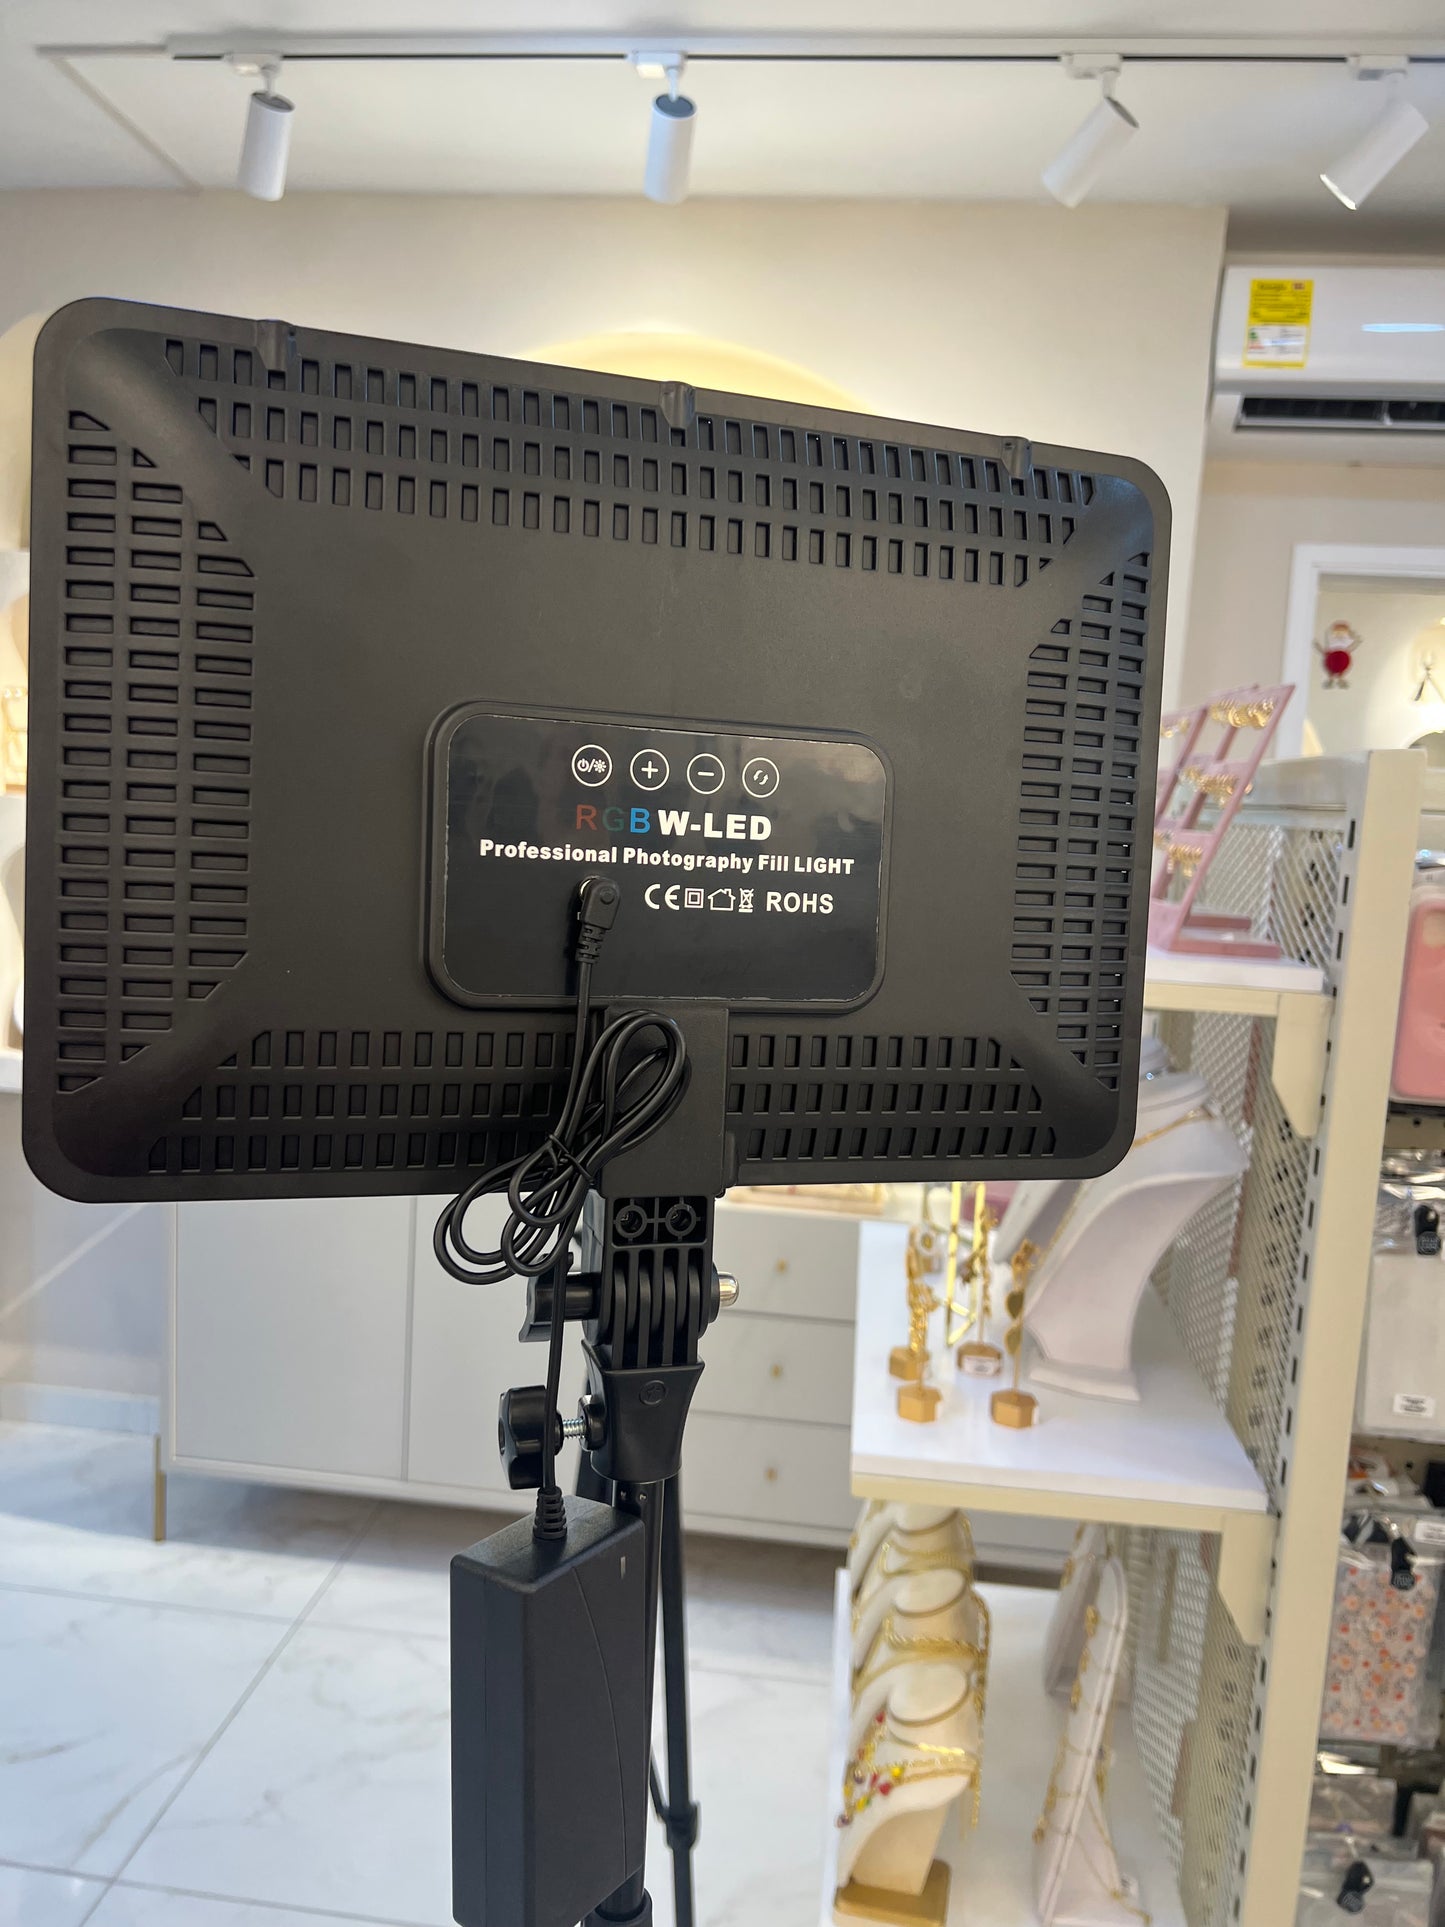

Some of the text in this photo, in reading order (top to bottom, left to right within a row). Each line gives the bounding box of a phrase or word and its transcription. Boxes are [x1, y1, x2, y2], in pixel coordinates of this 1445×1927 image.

[575, 804, 773, 841] RGB W-LED
[479, 838, 855, 876] Professional Photography Fill LIGHT
[643, 883, 834, 915] CE ROHS
